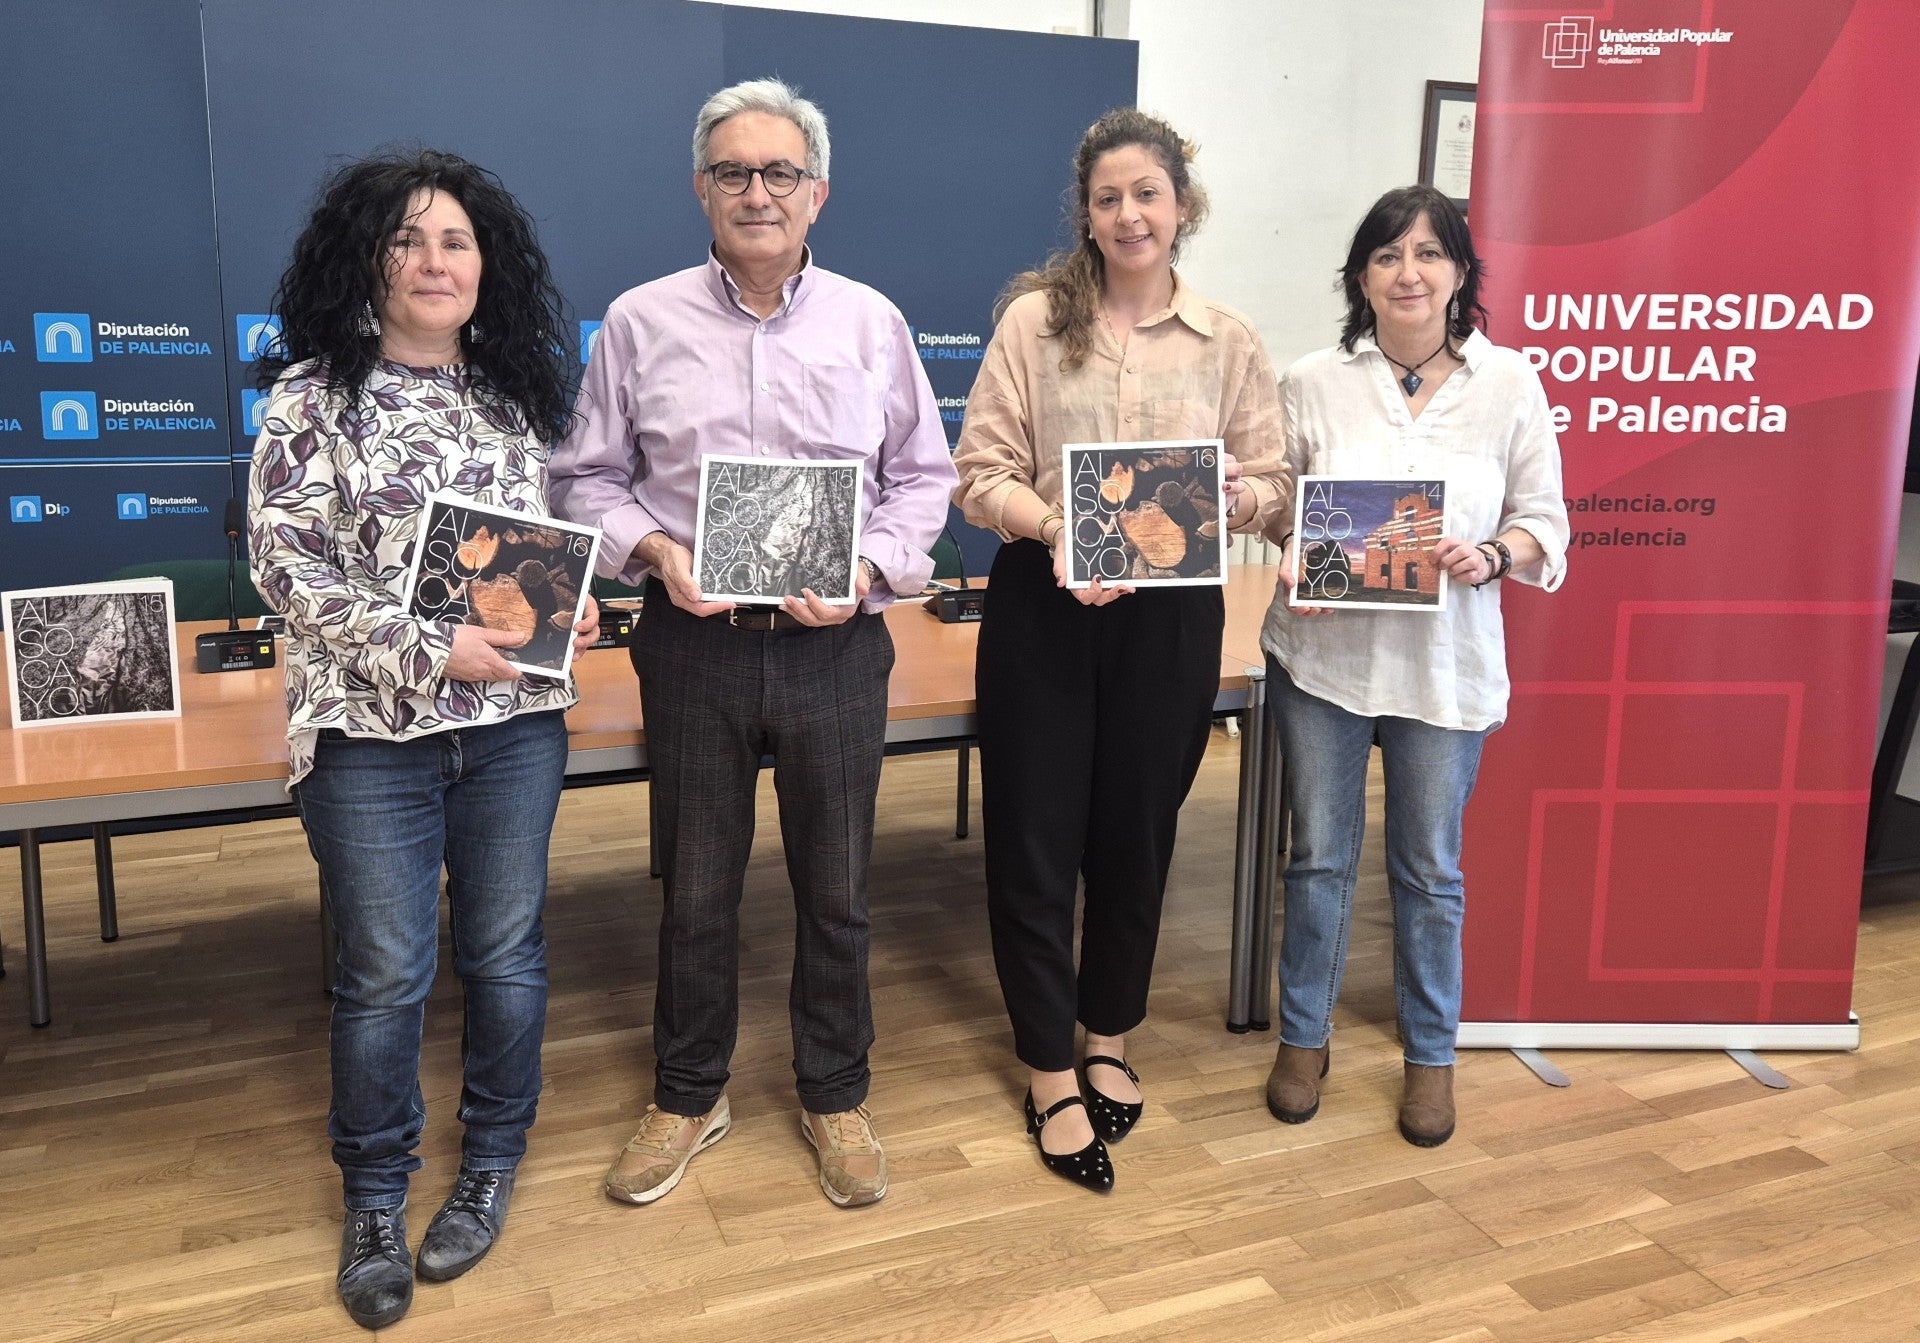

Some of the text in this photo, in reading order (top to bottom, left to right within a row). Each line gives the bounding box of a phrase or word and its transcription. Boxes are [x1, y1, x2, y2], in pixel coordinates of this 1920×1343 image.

[1597, 43, 1660, 55] de Palencia
[1600, 28, 1734, 46] Universidad Popular
[1524, 293, 1874, 331] UNIVERSIDAD
[98, 322, 190, 338] Diputación
[918, 333, 980, 346] Diputación
[100, 341, 212, 355] DE PALENCIA
[919, 348, 984, 359] DE PALENC
[1521, 345, 1757, 382] POPULAR
[104, 399, 194, 415] Diputación
[1552, 395, 1787, 433] e Palencia
[105, 417, 216, 431] DE PALENCIA
[1075, 452, 1119, 482] AL
[1191, 448, 1215, 468] 16
[711, 465, 755, 496] AL
[832, 469, 853, 488] 15
[1419, 483, 1442, 501] 14
[45, 503, 70, 516] Dip
[150, 496, 198, 506] Diputación
[150, 505, 209, 514] DE PALENCIA
[1075, 484, 1125, 515] SO
[1306, 483, 1347, 510] AL
[1563, 493, 1716, 516] palencia.org
[709, 496, 761, 528] SO
[1304, 511, 1352, 540] SO
[431, 508, 479, 546] AL
[1075, 516, 1126, 547] CA
[1569, 527, 1687, 549] vpalencia
[565, 534, 589, 557] 16
[706, 529, 756, 560] CA
[1302, 541, 1348, 570] CA
[424, 540, 483, 580] SO
[1076, 547, 1127, 578] YO
[705, 560, 757, 593] YO
[1302, 570, 1349, 599] YO
[140, 595, 164, 613] 15
[418, 576, 470, 615] CA
[17, 599, 66, 628] AL
[18, 627, 74, 659] SO
[21, 659, 76, 688] CA
[22, 686, 79, 720] YO
